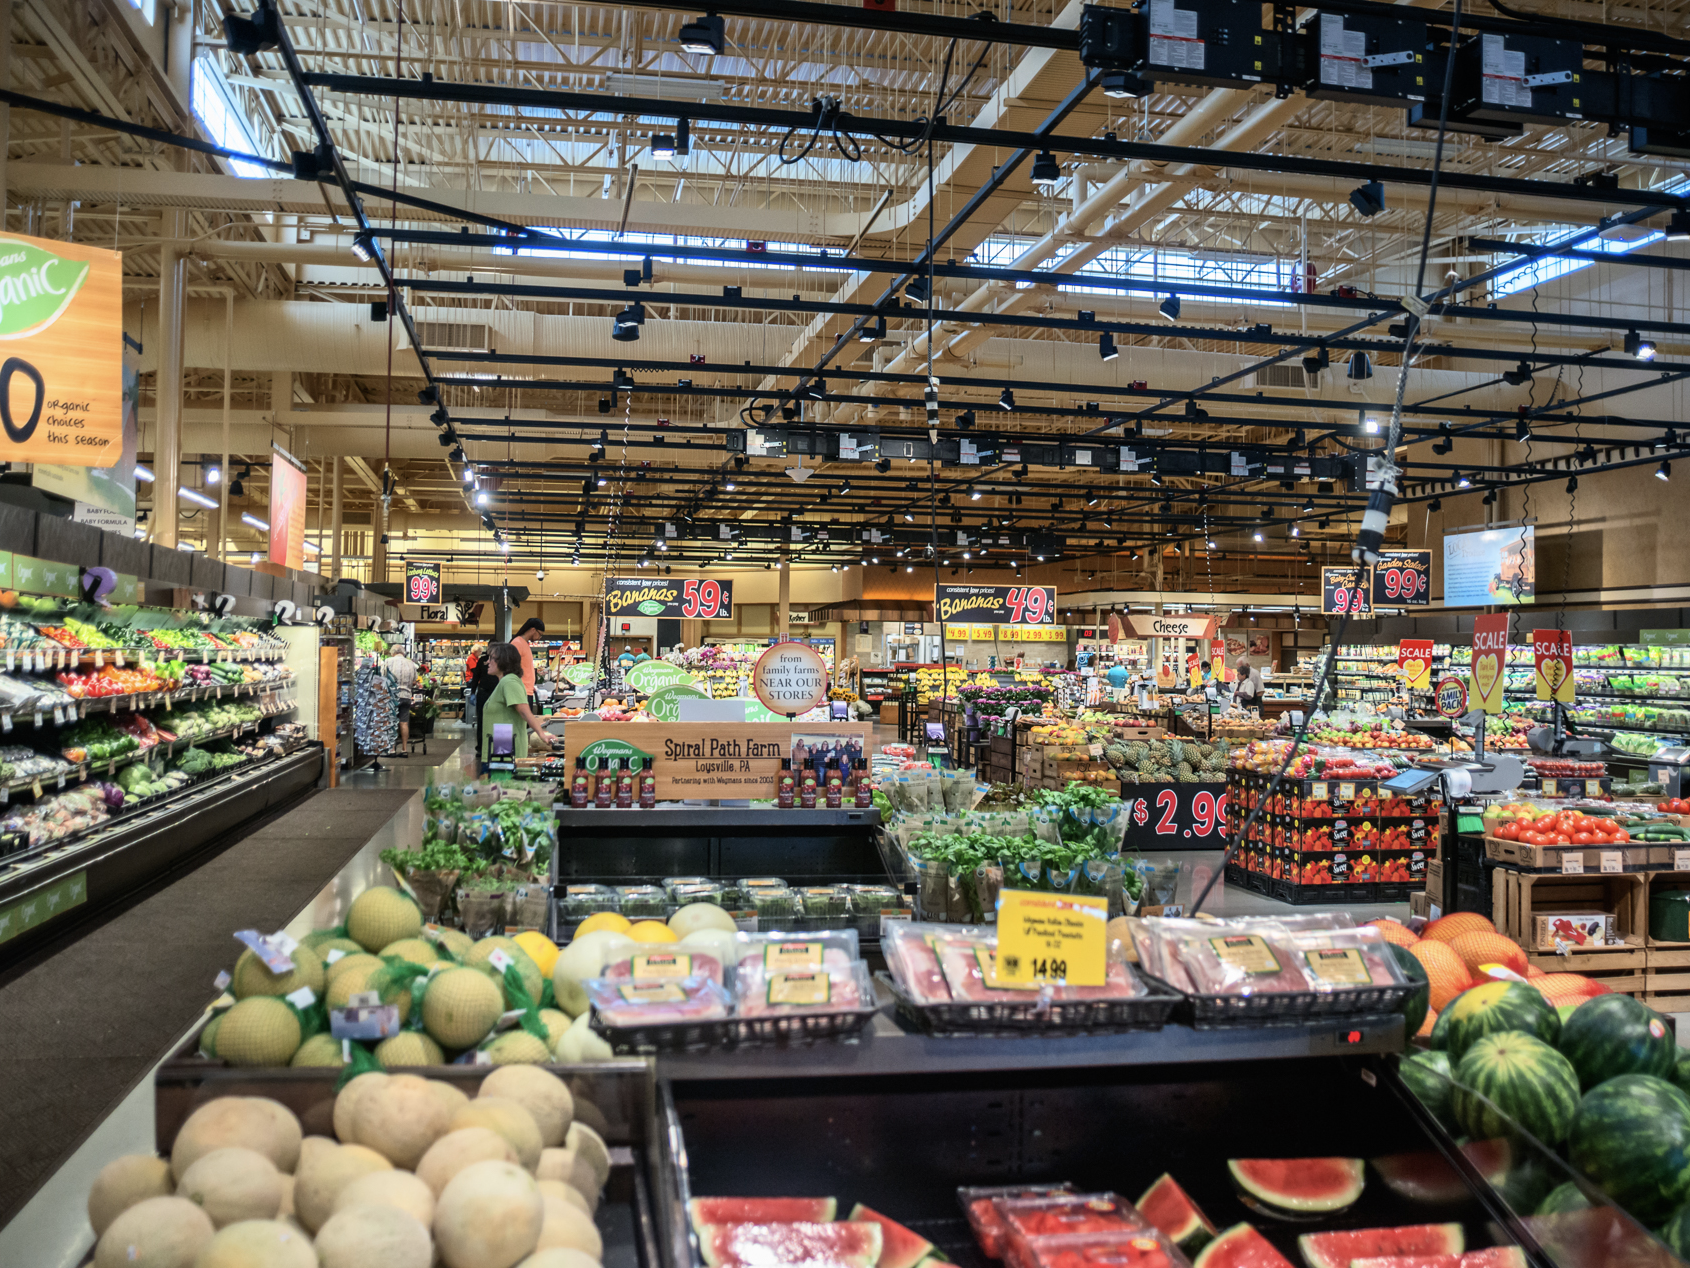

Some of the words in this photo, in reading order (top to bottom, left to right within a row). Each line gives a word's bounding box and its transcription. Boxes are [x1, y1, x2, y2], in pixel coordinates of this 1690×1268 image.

[47, 430, 69, 444] this
[75, 434, 110, 447] season
[1377, 558, 1402, 571] Garden
[1403, 559, 1428, 571] Salad
[606, 588, 678, 613] Bananas
[421, 606, 448, 620] Floral
[937, 596, 1004, 620] Bananas
[1153, 620, 1189, 635] Cheese
[1474, 631, 1505, 650] SCALE
[1211, 647, 1224, 656] SCALE
[1400, 648, 1431, 658] SCALE
[1535, 642, 1570, 657] SCALE
[780, 653, 802, 663] from
[1188, 658, 1199, 668] SCALE
[642, 665, 674, 676] Wegmans
[762, 665, 791, 676] family
[794, 665, 820, 674] farms
[630, 671, 686, 693] Organic
[760, 677, 793, 688] NEAR
[796, 677, 822, 688] OUR
[664, 690, 700, 702] Wegmans
[768, 690, 814, 700] STORES
[1437, 689, 1464, 703] FAMILY
[1441, 698, 1463, 711] PACK
[592, 743, 633, 758] Wegmans
[665, 738, 706, 762] Spiral
[710, 738, 742, 757] Path
[745, 738, 781, 757] Farm
[739, 760, 751, 772] PA
[672, 777, 701, 785] Partnering
[716, 777, 742, 785] Wegmans
[758, 776, 774, 784] 2003
